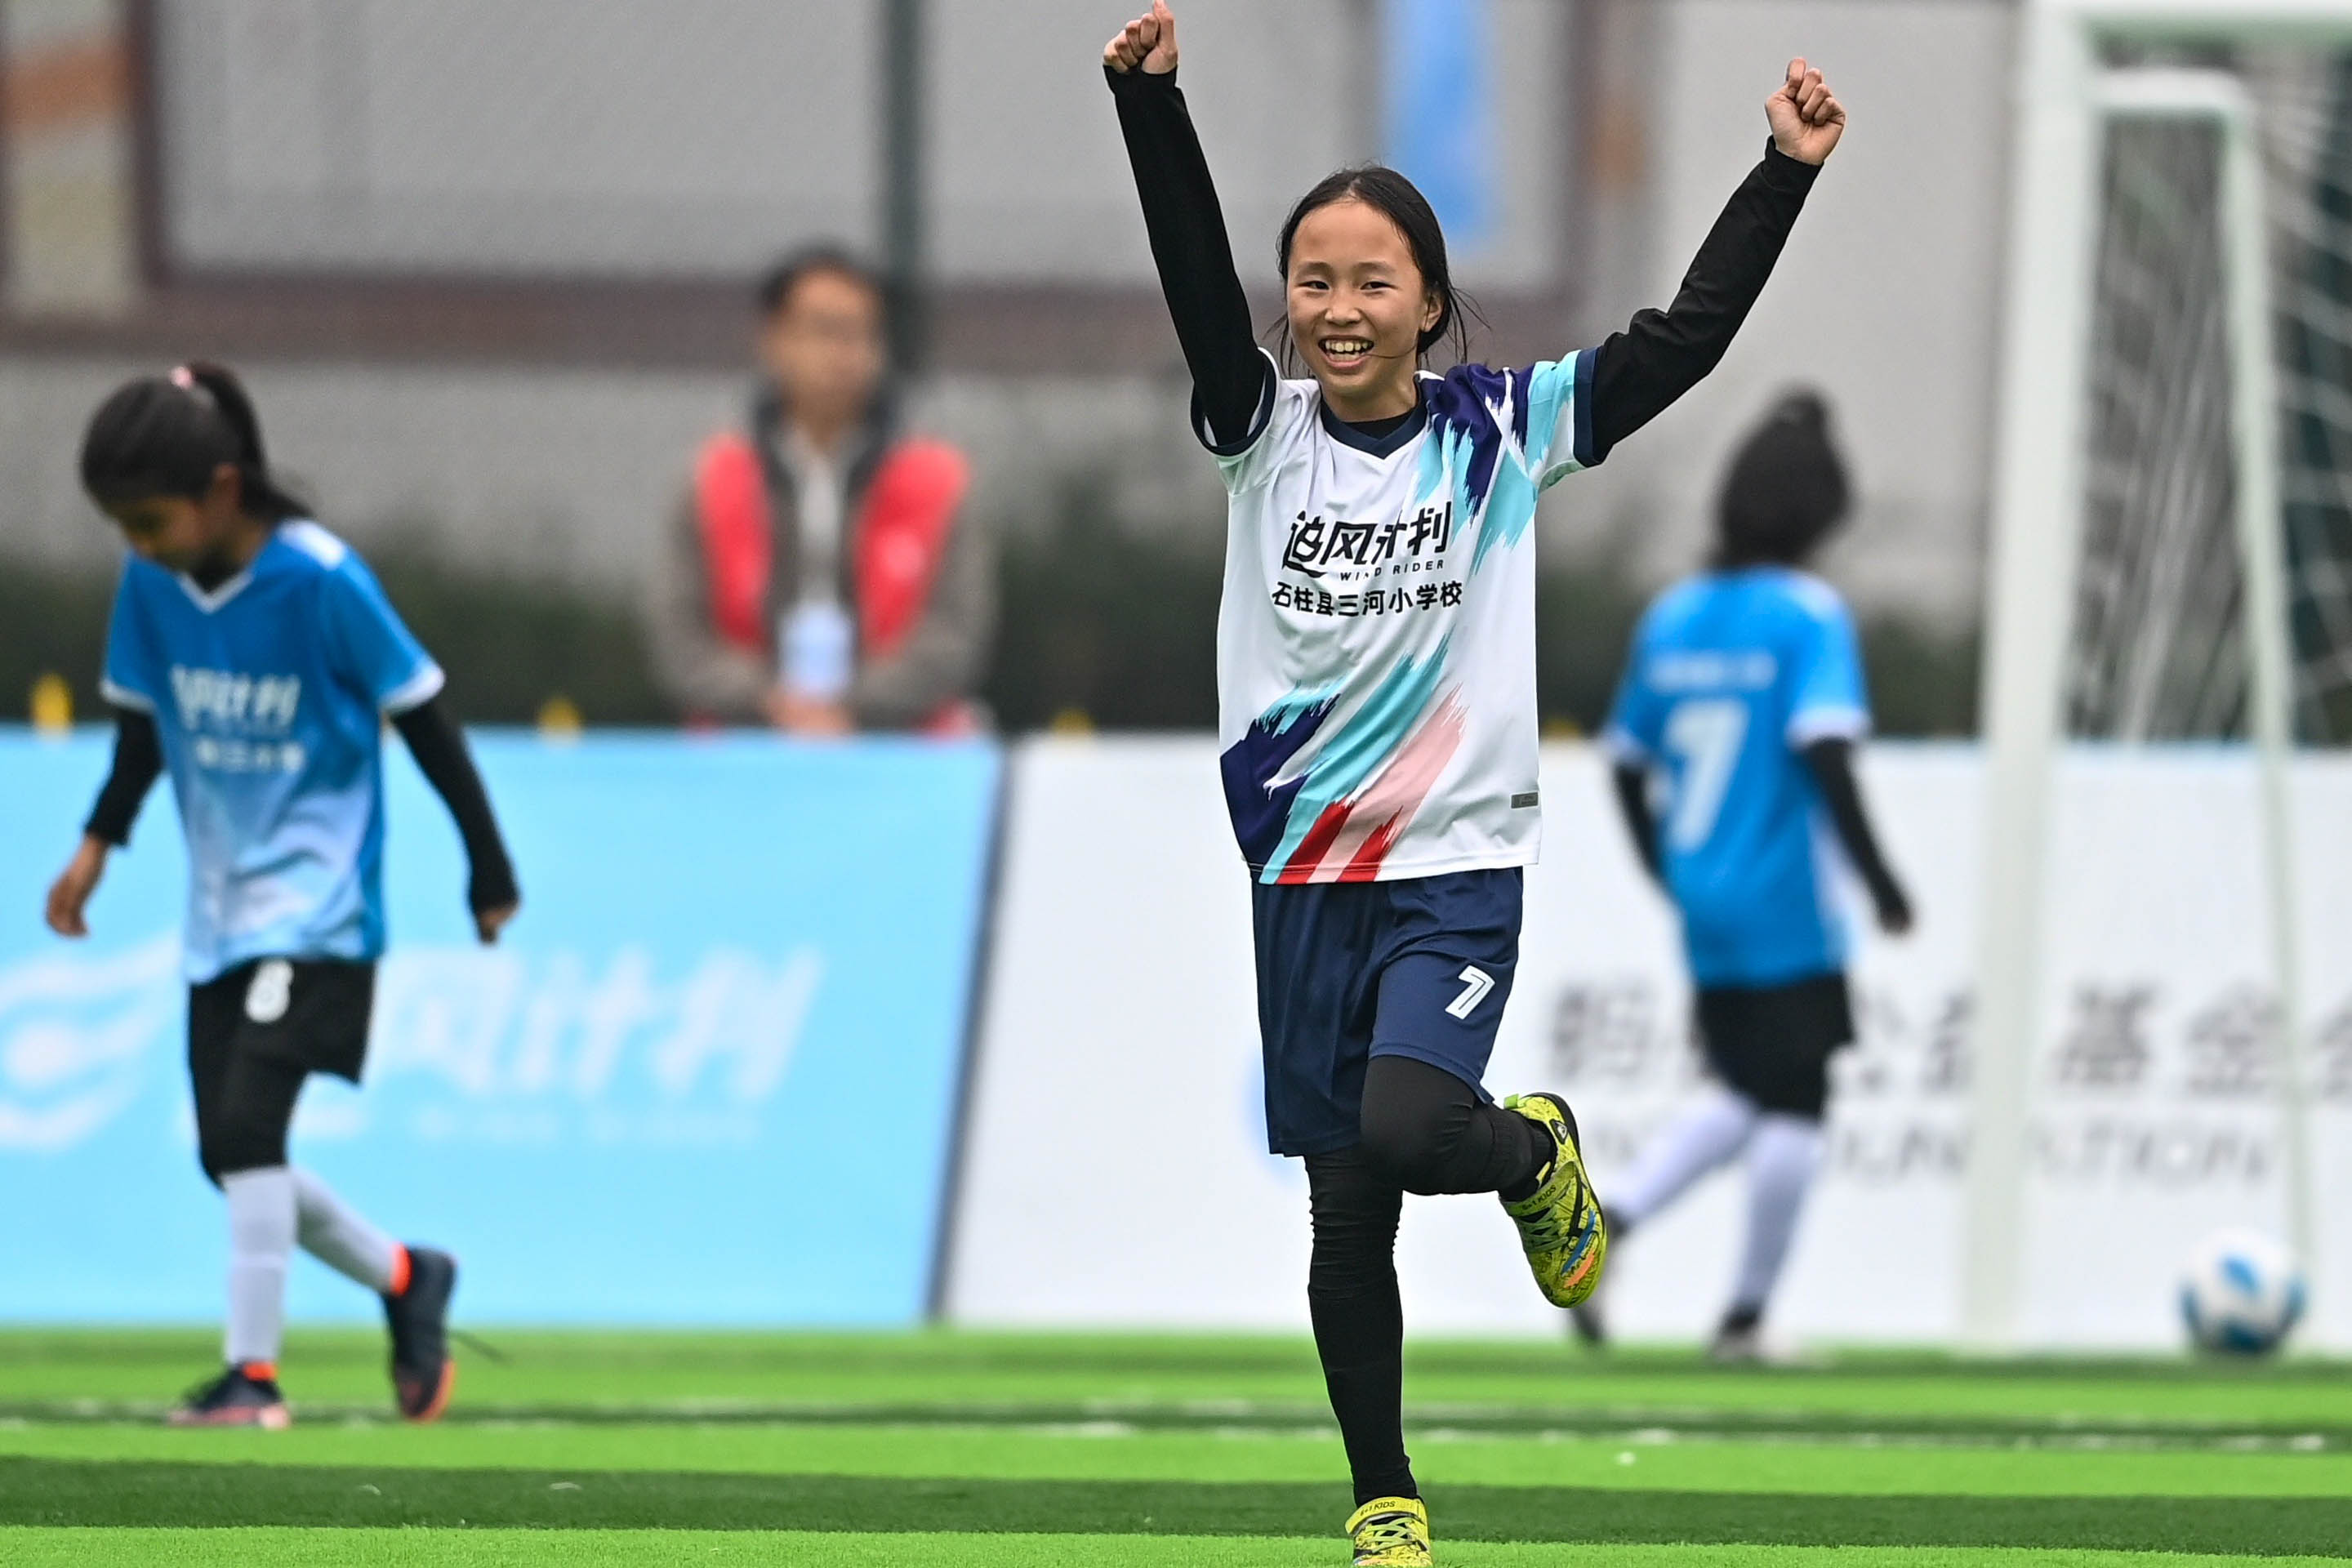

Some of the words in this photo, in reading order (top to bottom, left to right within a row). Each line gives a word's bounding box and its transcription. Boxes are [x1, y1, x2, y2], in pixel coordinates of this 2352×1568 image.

[1392, 559, 1444, 575] RIDER
[1271, 581, 1463, 617] 石柱县三河小学校
[1664, 699, 1749, 854] 7
[246, 960, 293, 1022] 8
[1445, 964, 1495, 1019] 7
